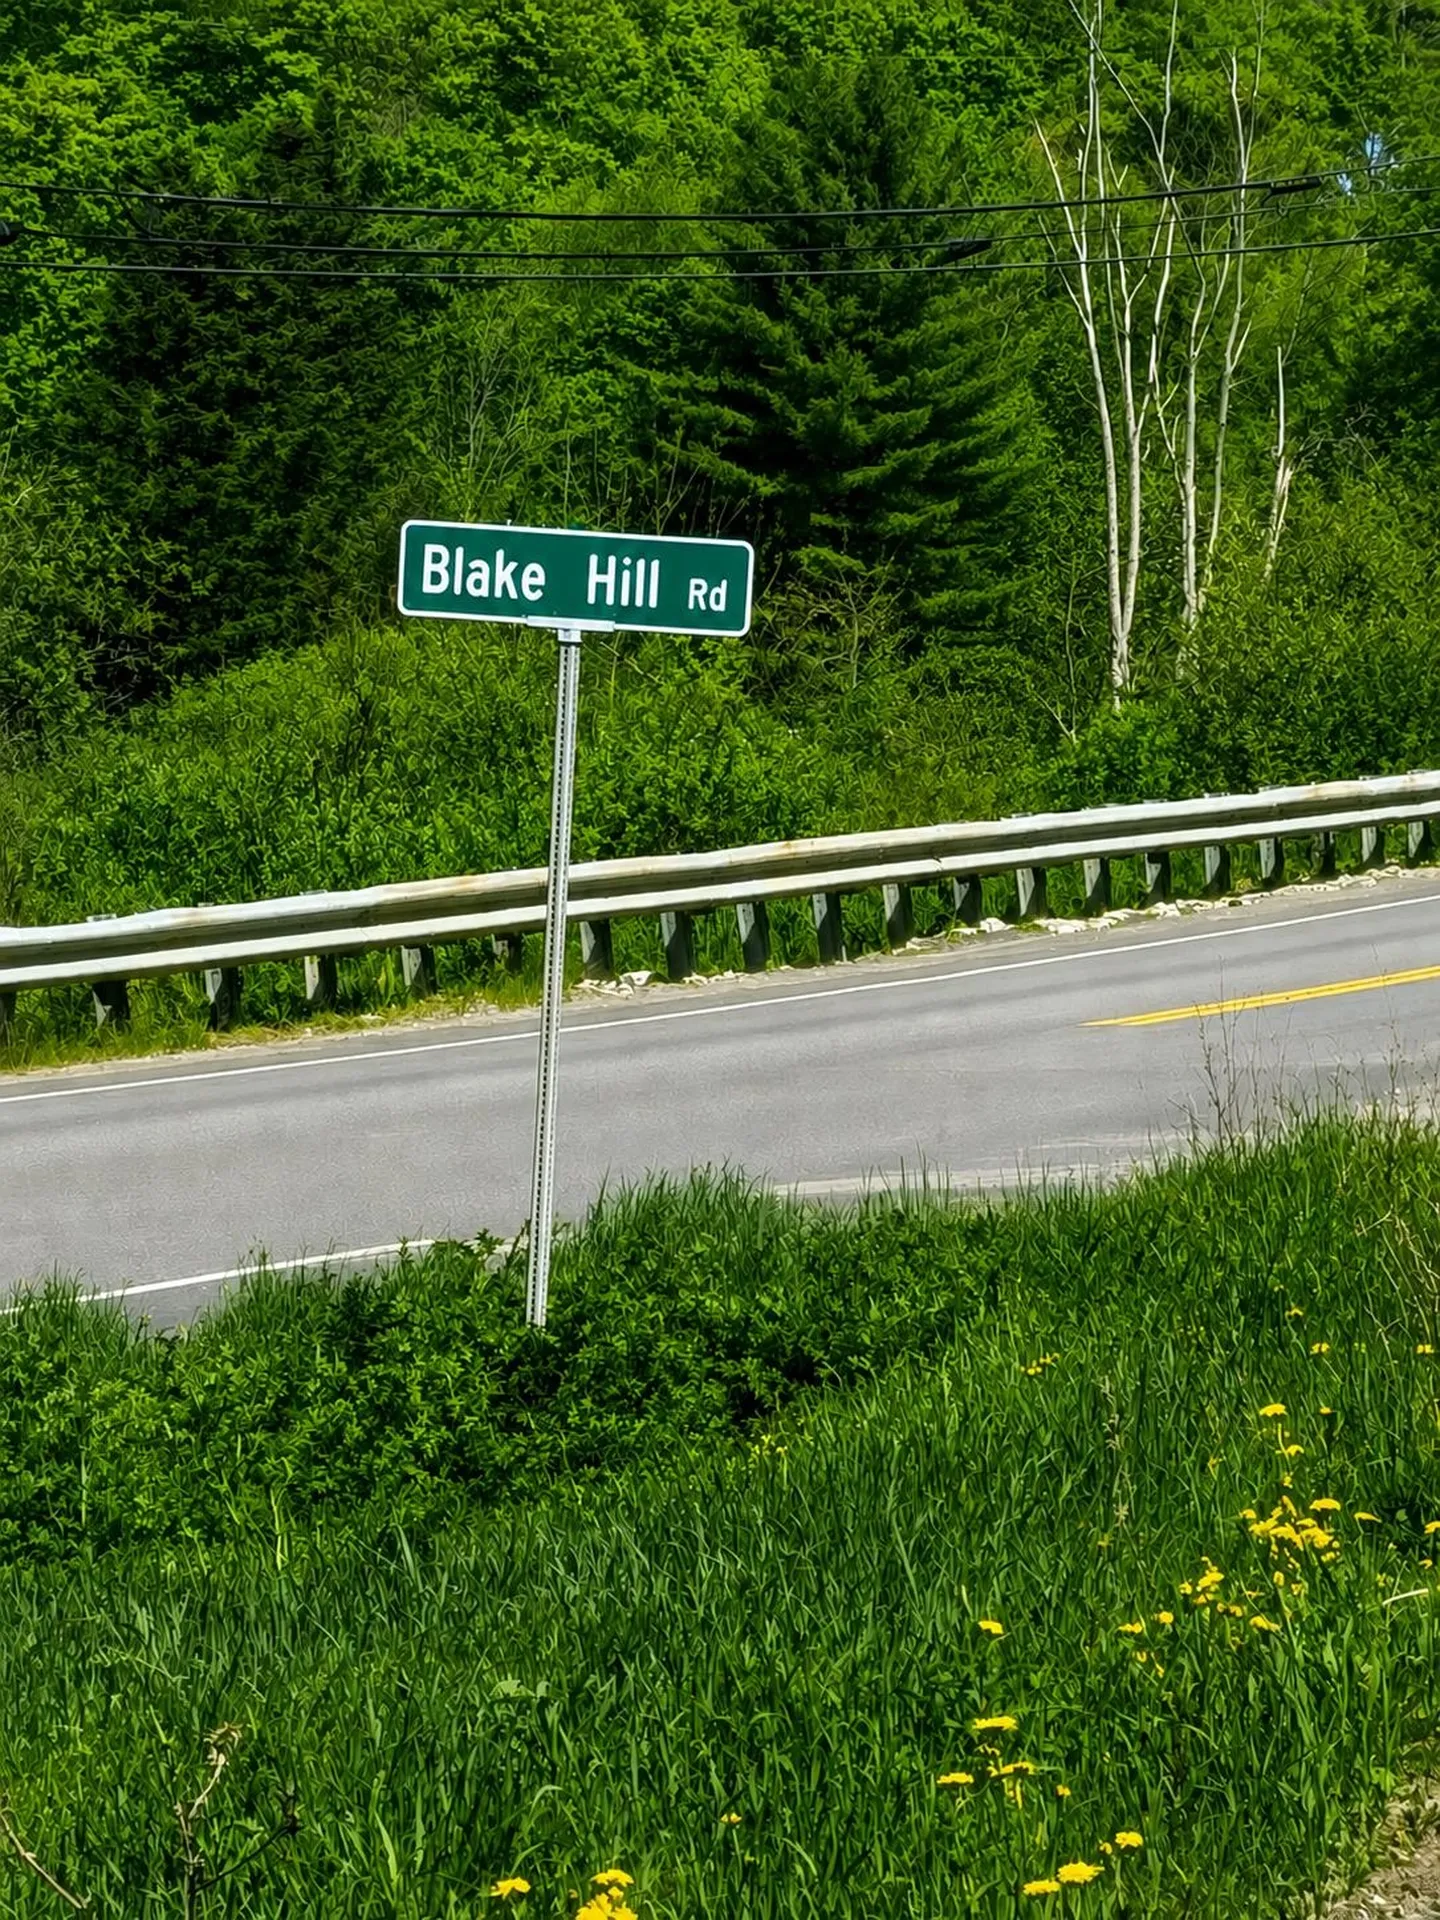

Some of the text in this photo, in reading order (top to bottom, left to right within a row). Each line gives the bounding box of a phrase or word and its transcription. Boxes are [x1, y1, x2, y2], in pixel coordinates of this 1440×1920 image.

[422, 543, 728, 612] Blake Hill Rd
